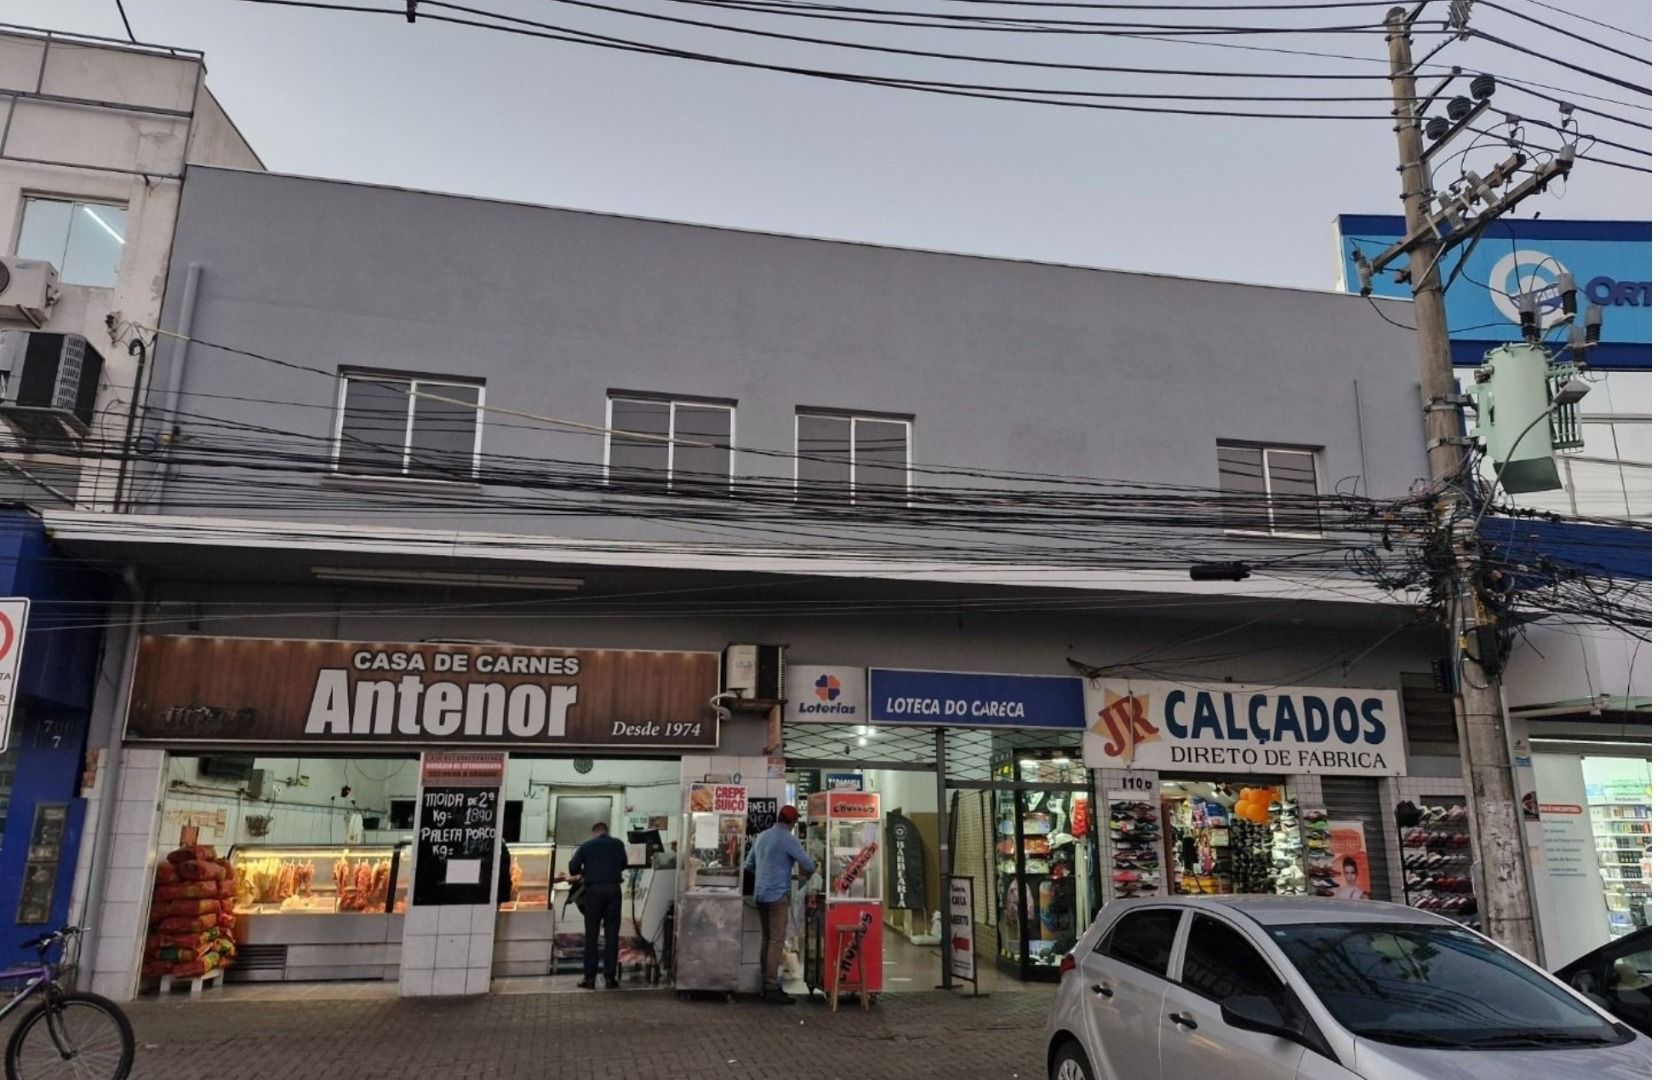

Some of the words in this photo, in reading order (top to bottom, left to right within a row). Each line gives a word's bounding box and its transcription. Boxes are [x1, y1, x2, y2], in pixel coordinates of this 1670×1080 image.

[354, 651, 425, 672] CASA
[434, 653, 469, 673] DE
[476, 655, 580, 676] CARNES
[304, 668, 578, 737] Antenor
[798, 702, 856, 715] Loterias
[886, 697, 940, 716] LOTECA
[944, 699, 968, 716] DO
[971, 700, 1025, 718] CARECA
[1098, 694, 1160, 758] JR
[1164, 689, 1387, 745] CALÇADOS
[611, 720, 660, 737] Desde
[664, 721, 702, 737] 1974
[1171, 745, 1258, 766] DIRETO
[1264, 749, 1292, 767] DE
[715, 786, 746, 799] CREPE
[714, 800, 745, 813] SUIÇO
